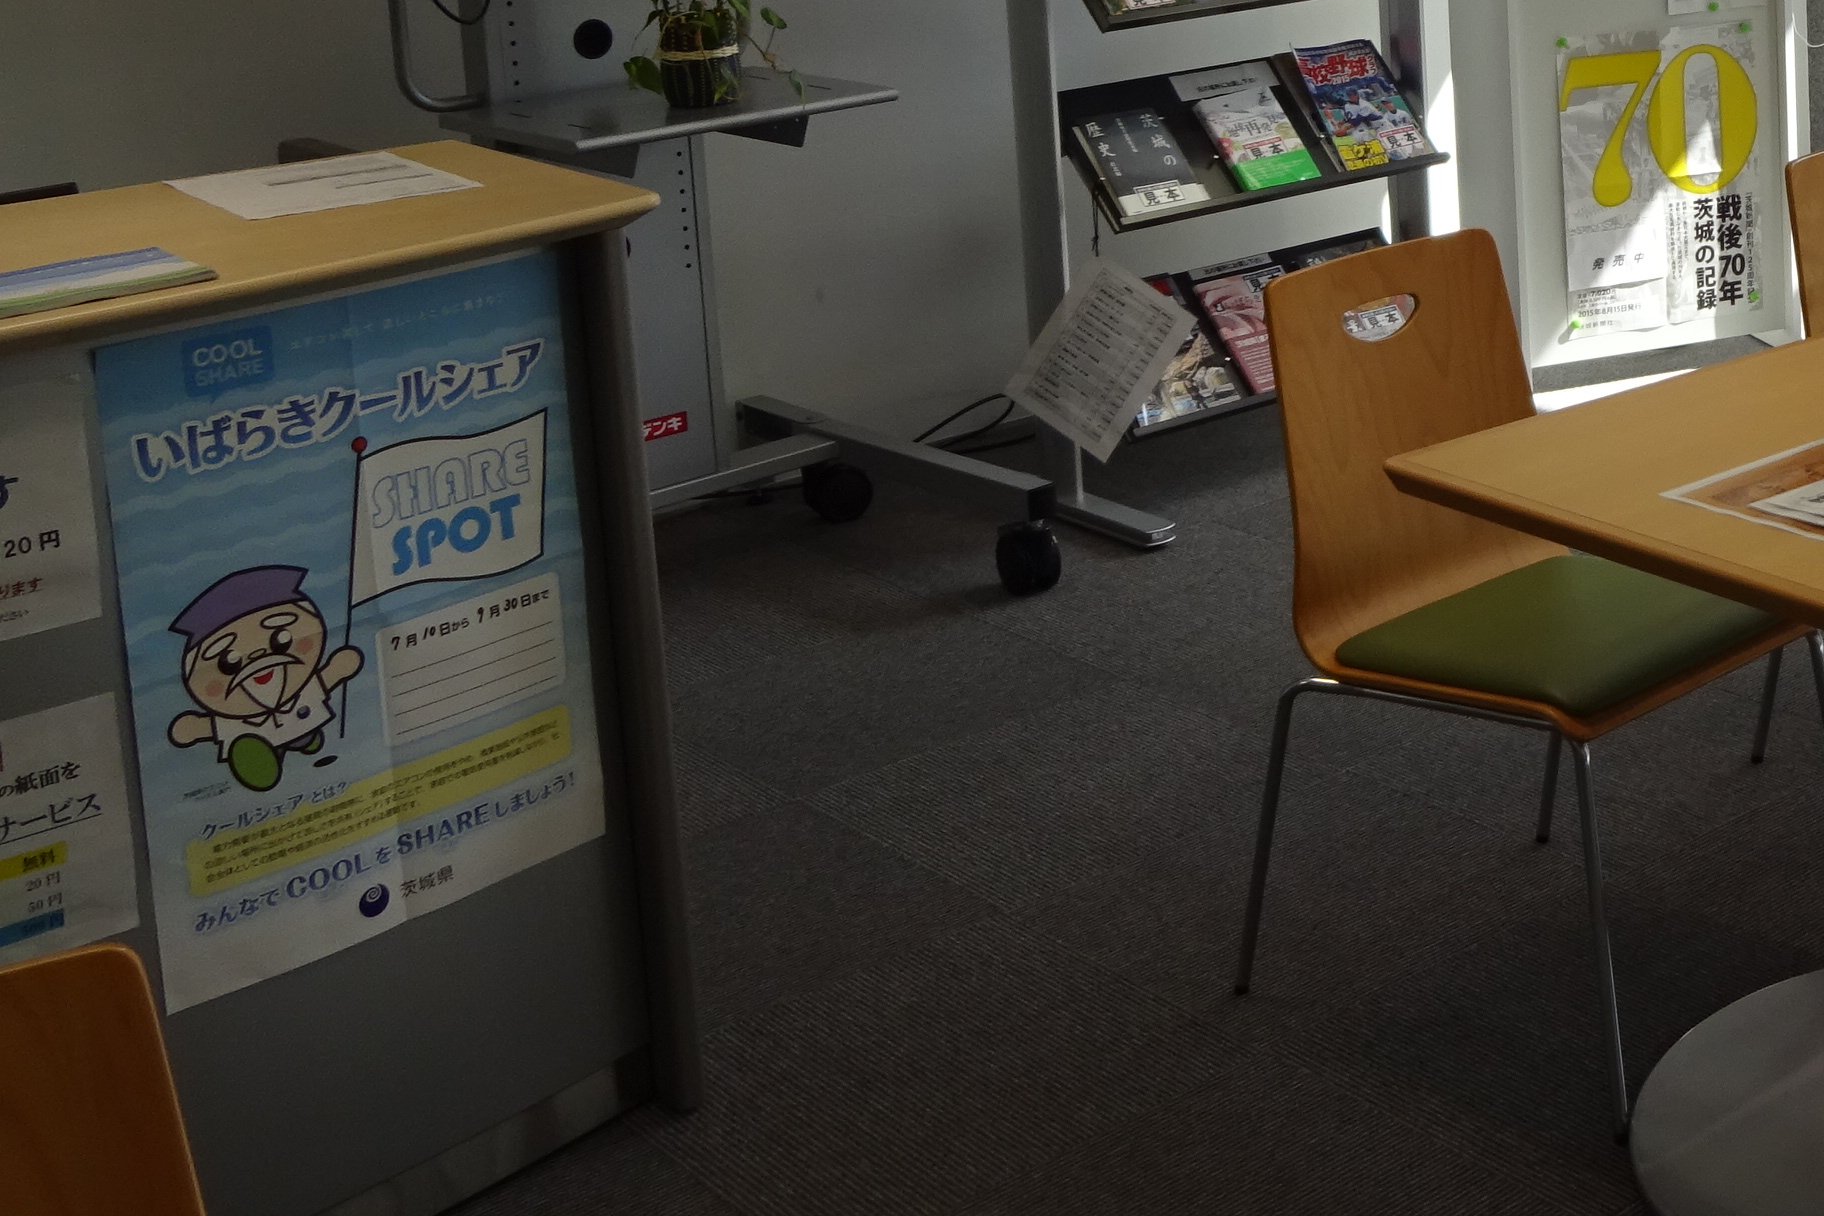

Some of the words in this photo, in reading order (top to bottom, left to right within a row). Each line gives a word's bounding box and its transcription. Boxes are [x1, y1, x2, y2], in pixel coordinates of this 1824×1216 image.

[1387, 132, 1418, 149] 見本
[1559, 44, 1758, 207] 70
[1145, 187, 1181, 205] 見本
[1592, 252, 1644, 271] 発売中
[1693, 197, 1717, 310] 茨城の記録
[1716, 194, 1746, 306] 戦後70年
[1367, 312, 1401, 329] 見本
[193, 339, 264, 368] COOL
[195, 362, 265, 387] SHARE
[130, 339, 544, 483] いばらきクールシェア
[372, 438, 531, 529] SHARE
[392, 493, 521, 576] SPOT
[401, 864, 455, 899] 茨城県
